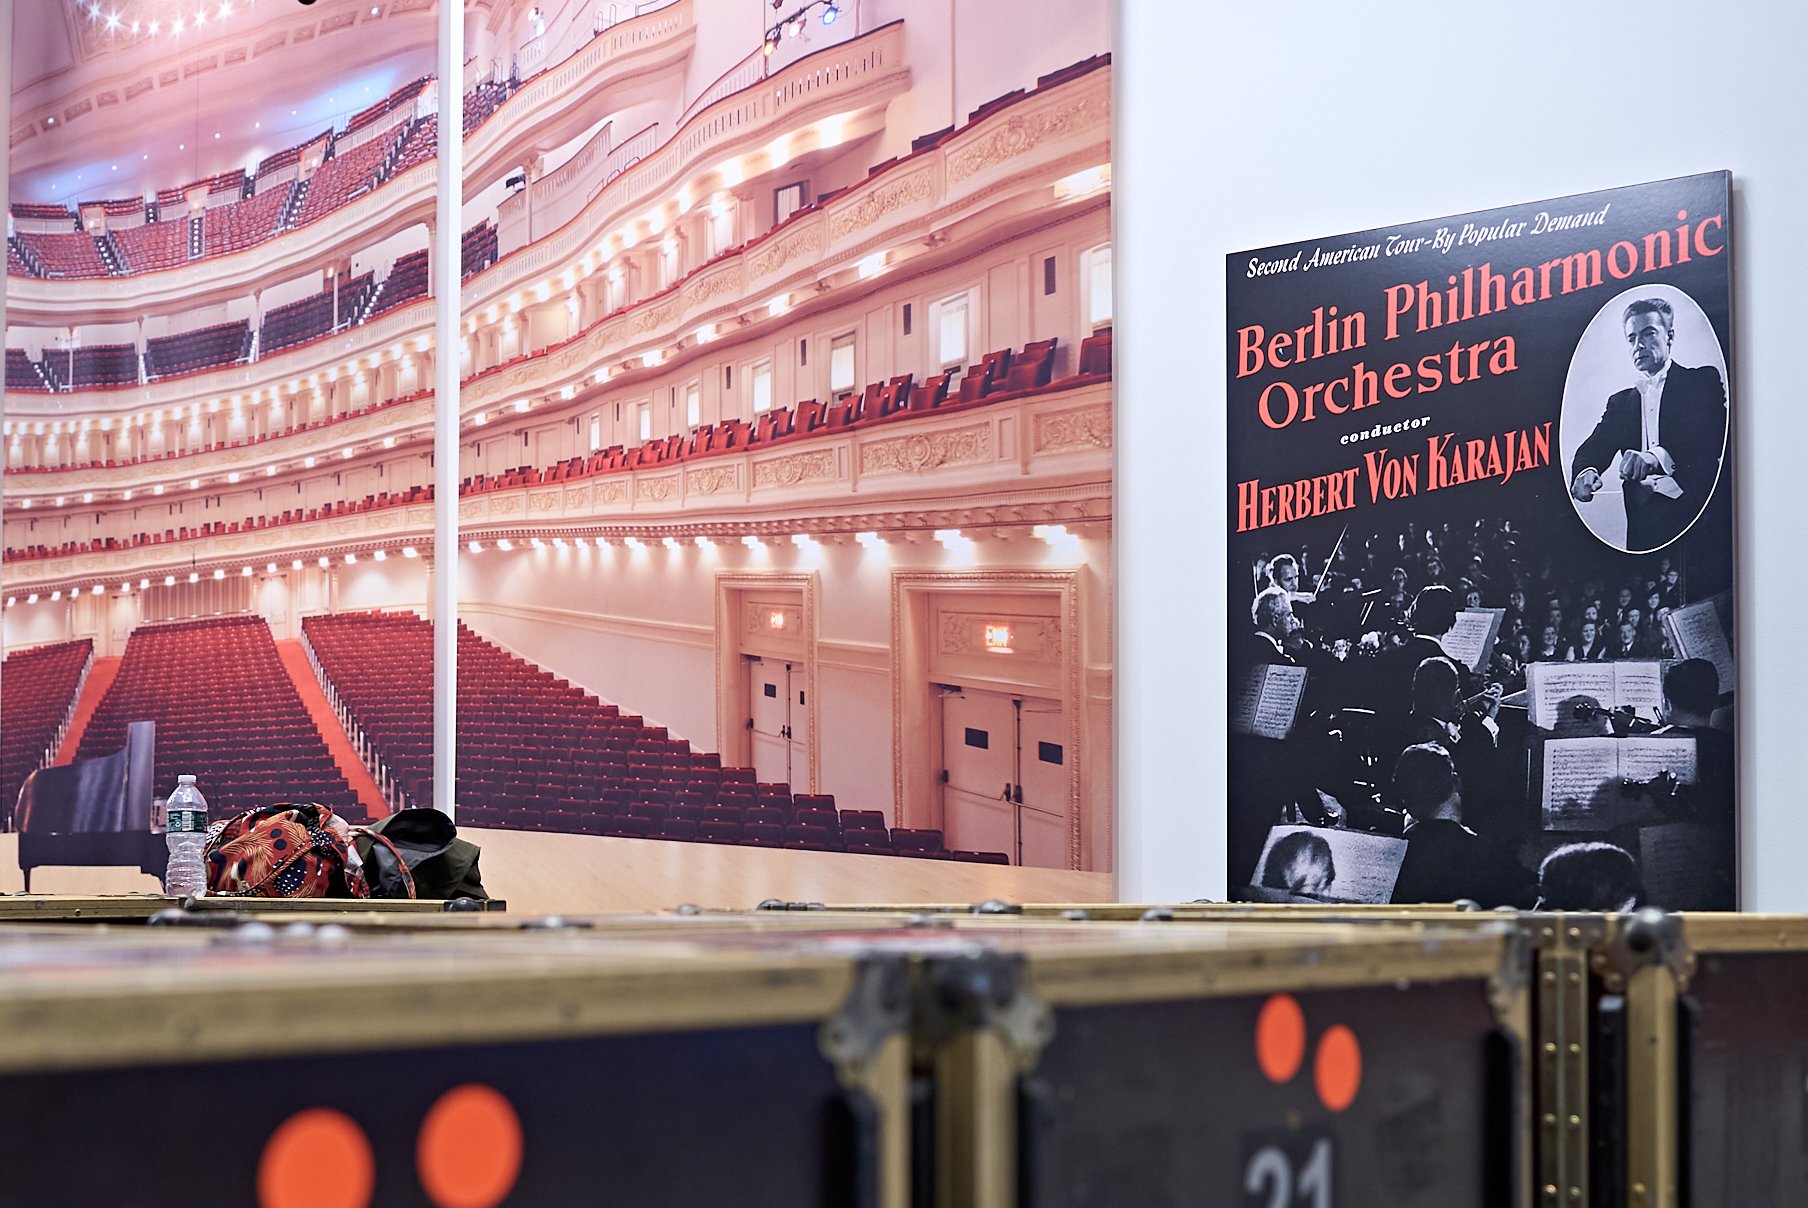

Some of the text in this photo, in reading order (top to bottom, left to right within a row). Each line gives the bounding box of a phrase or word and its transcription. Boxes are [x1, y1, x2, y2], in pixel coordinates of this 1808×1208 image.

[1246, 203, 1612, 279] Second American Tour-By Popular Demand
[1235, 209, 1727, 379] Berlin Philharmonic
[1256, 334, 1519, 430] Orchestra
[1339, 414, 1432, 446] conductor
[1236, 467, 1360, 533] HERBERT
[1426, 421, 1553, 493] KARAJAN
